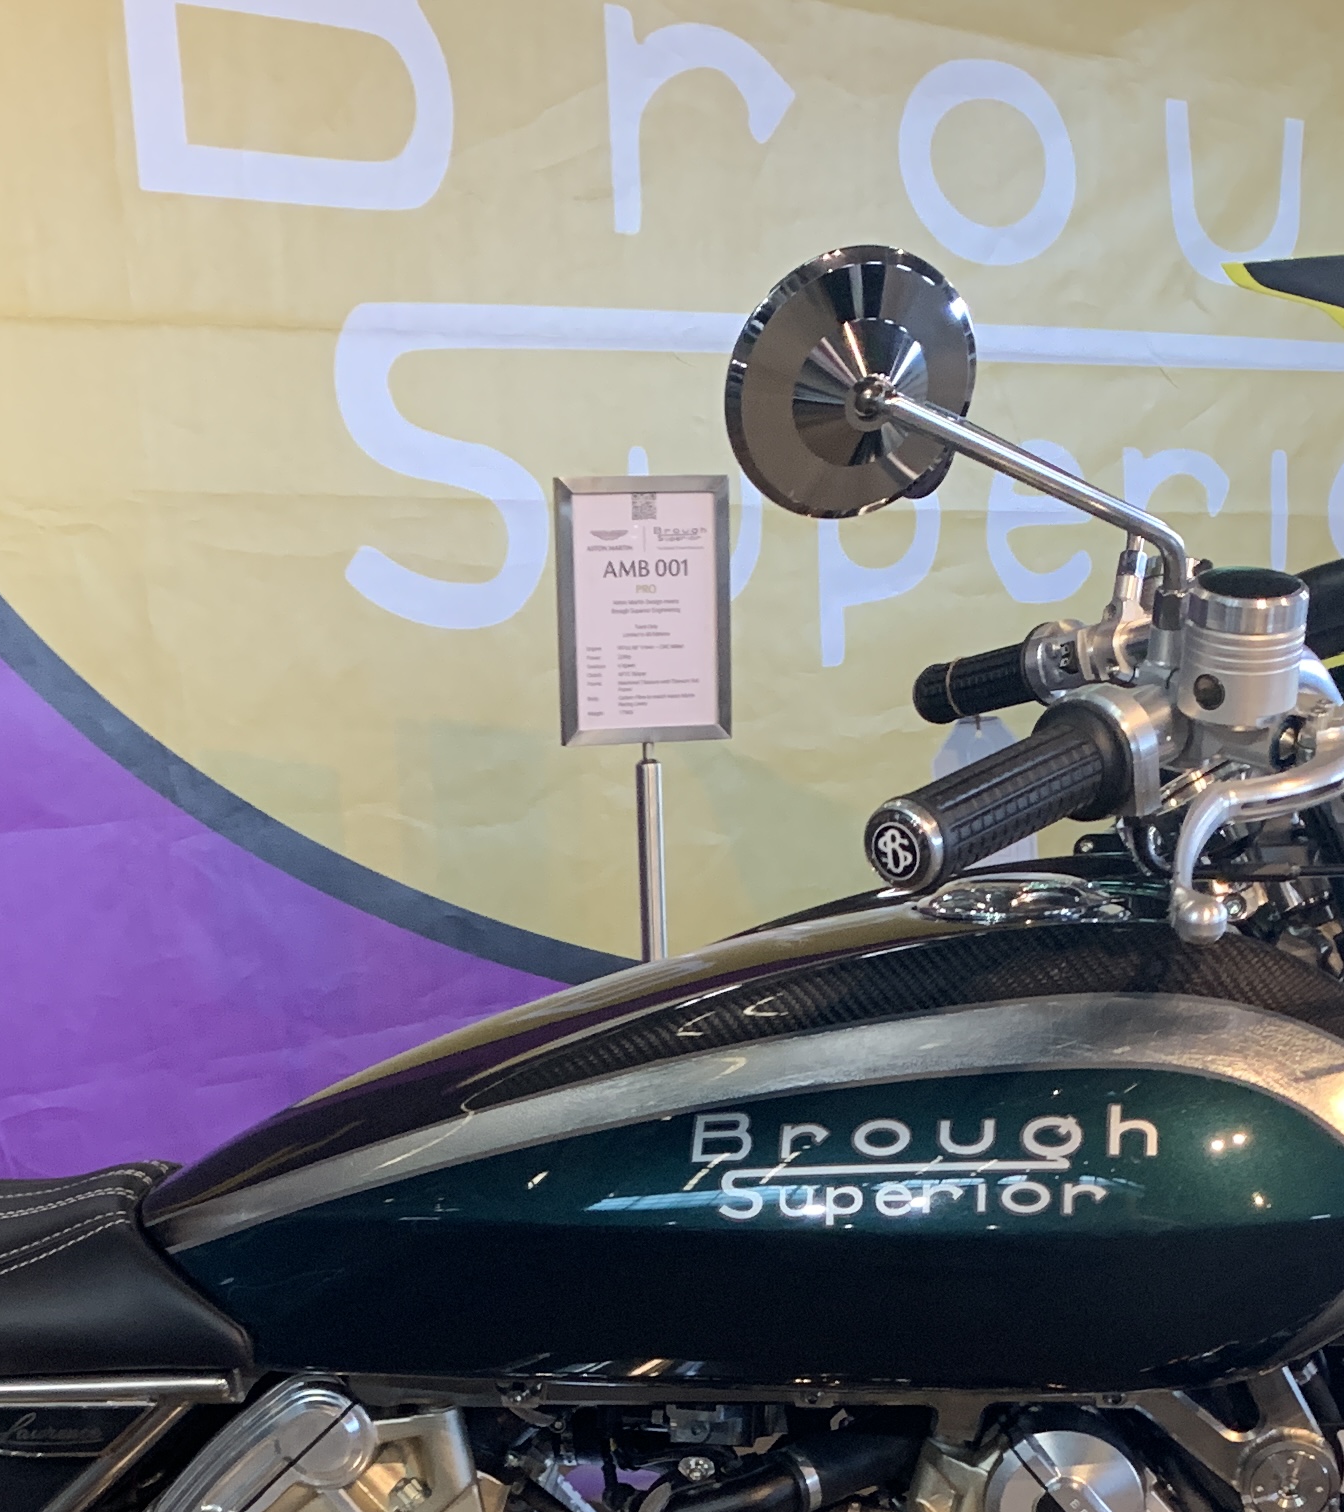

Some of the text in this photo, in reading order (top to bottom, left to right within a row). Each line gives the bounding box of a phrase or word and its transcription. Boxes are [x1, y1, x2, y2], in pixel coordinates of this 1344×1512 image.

[603, 558, 689, 578] AMB 001
[635, 583, 657, 594] PRO
[691, 1103, 1159, 1165] Brough
[718, 1159, 1109, 1226] Superior
